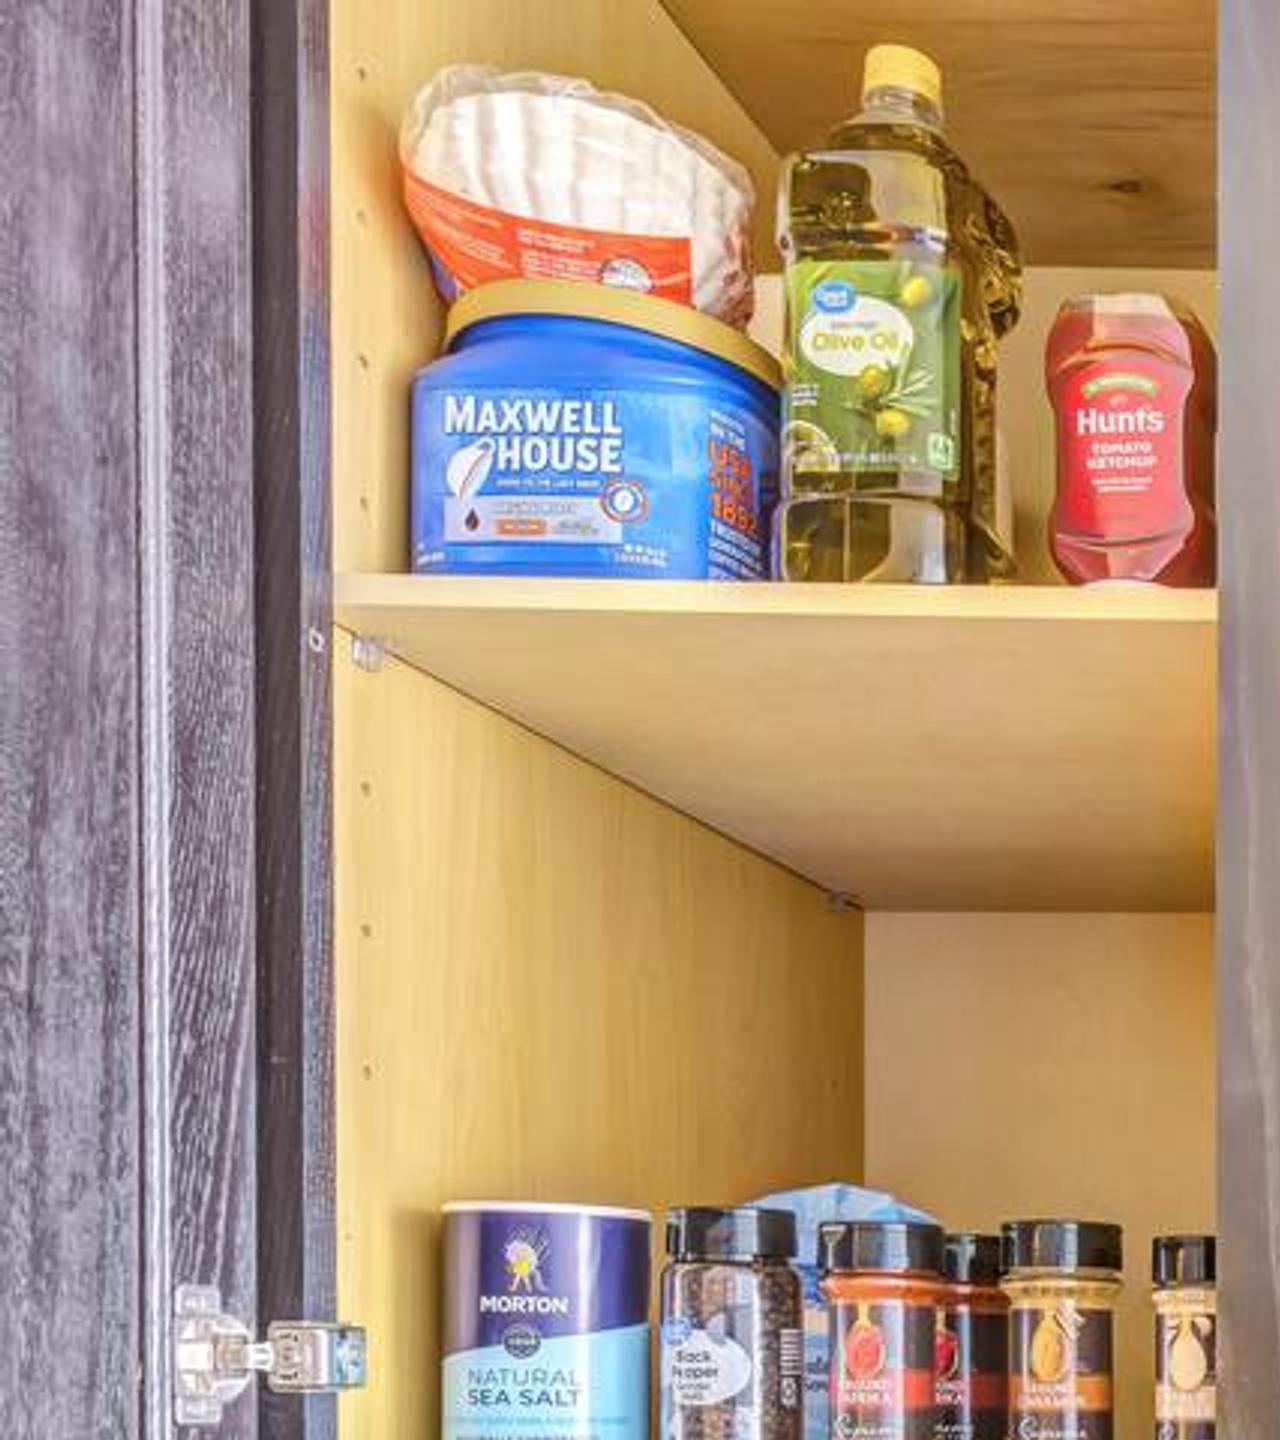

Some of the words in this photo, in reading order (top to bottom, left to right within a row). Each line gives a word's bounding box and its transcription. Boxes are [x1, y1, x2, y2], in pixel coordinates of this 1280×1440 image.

[445, 395, 623, 434] MAXWELL
[497, 437, 624, 473] HOUSE
[479, 1295, 569, 1313] MORTON
[467, 1368, 581, 1387] NATURAL
[467, 1389, 510, 1406] SEA
[519, 1389, 580, 1407] SALT
